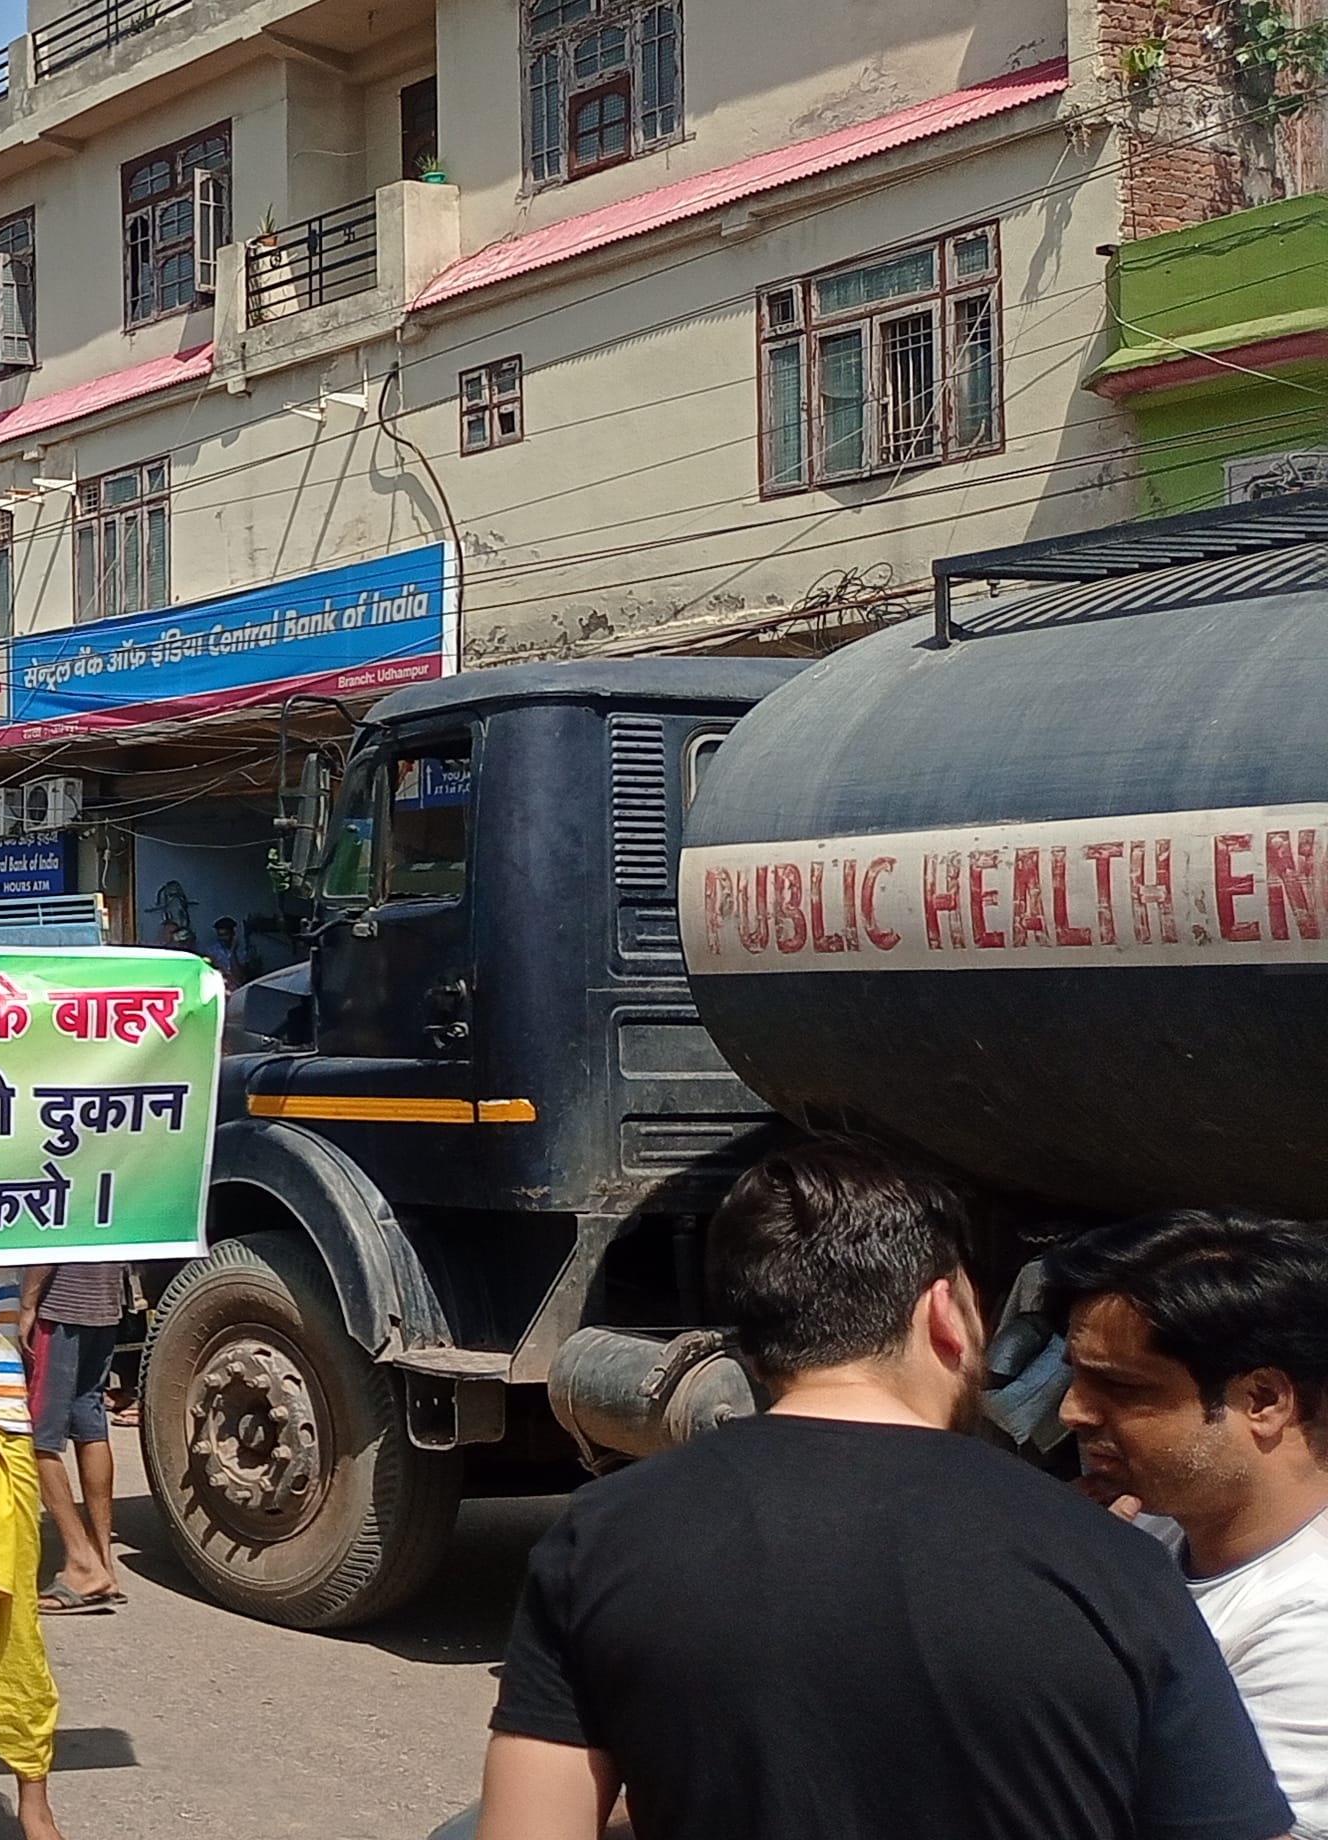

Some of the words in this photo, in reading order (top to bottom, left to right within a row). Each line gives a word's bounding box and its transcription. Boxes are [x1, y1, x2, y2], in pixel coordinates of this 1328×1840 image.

[208, 609, 277, 657] Central
[283, 597, 336, 642] Bank
[343, 591, 367, 629] of
[370, 584, 429, 625] India
[337, 673, 376, 690] Branch:
[377, 664, 429, 684] Udhampur
[3, 881, 31, 892] HOURS
[32, 879, 50, 892] ATM
[9, 854, 28, 872] Bank
[29, 852, 38, 870] of
[39, 852, 59, 870] India
[704, 856, 902, 955] PUBLIC
[923, 838, 1178, 951] HEALTH
[1213, 829, 1327, 942] EN
[48, 990, 181, 1045] बाहर
[33, 1083, 189, 1156] दुकान
